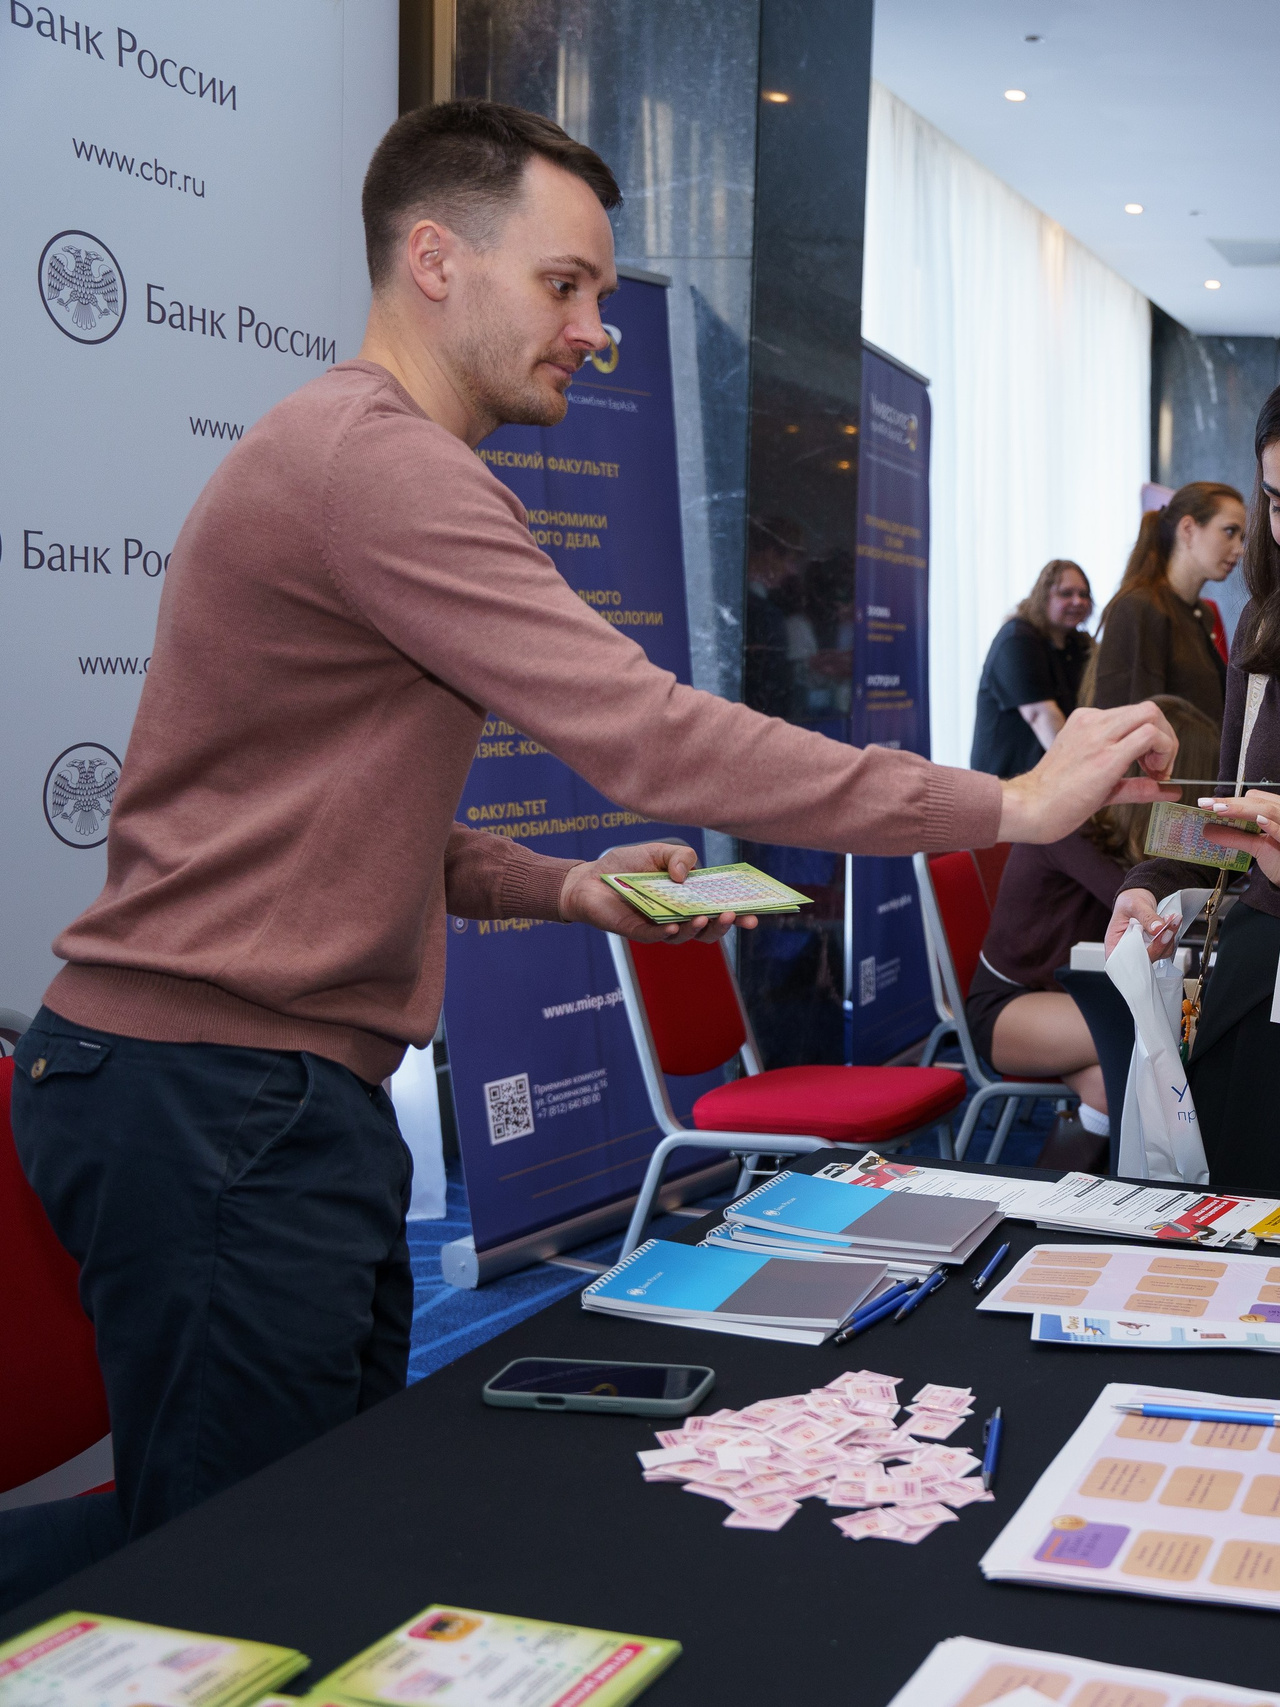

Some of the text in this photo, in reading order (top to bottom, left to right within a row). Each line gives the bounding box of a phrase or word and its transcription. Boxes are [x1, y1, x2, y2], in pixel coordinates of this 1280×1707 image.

[10, 0, 237, 111] Банк России
[72, 137, 206, 198] www.cbr.ru
[146, 283, 337, 365] Банк России
[547, 456, 620, 478] ФАКУЛЬТЕТ
[527, 509, 608, 530] КОНОМИКИ
[23, 530, 112, 575] Банк
[565, 532, 601, 551] ДЕЛА
[467, 799, 547, 821] ФАКУЛЬТЕТ
